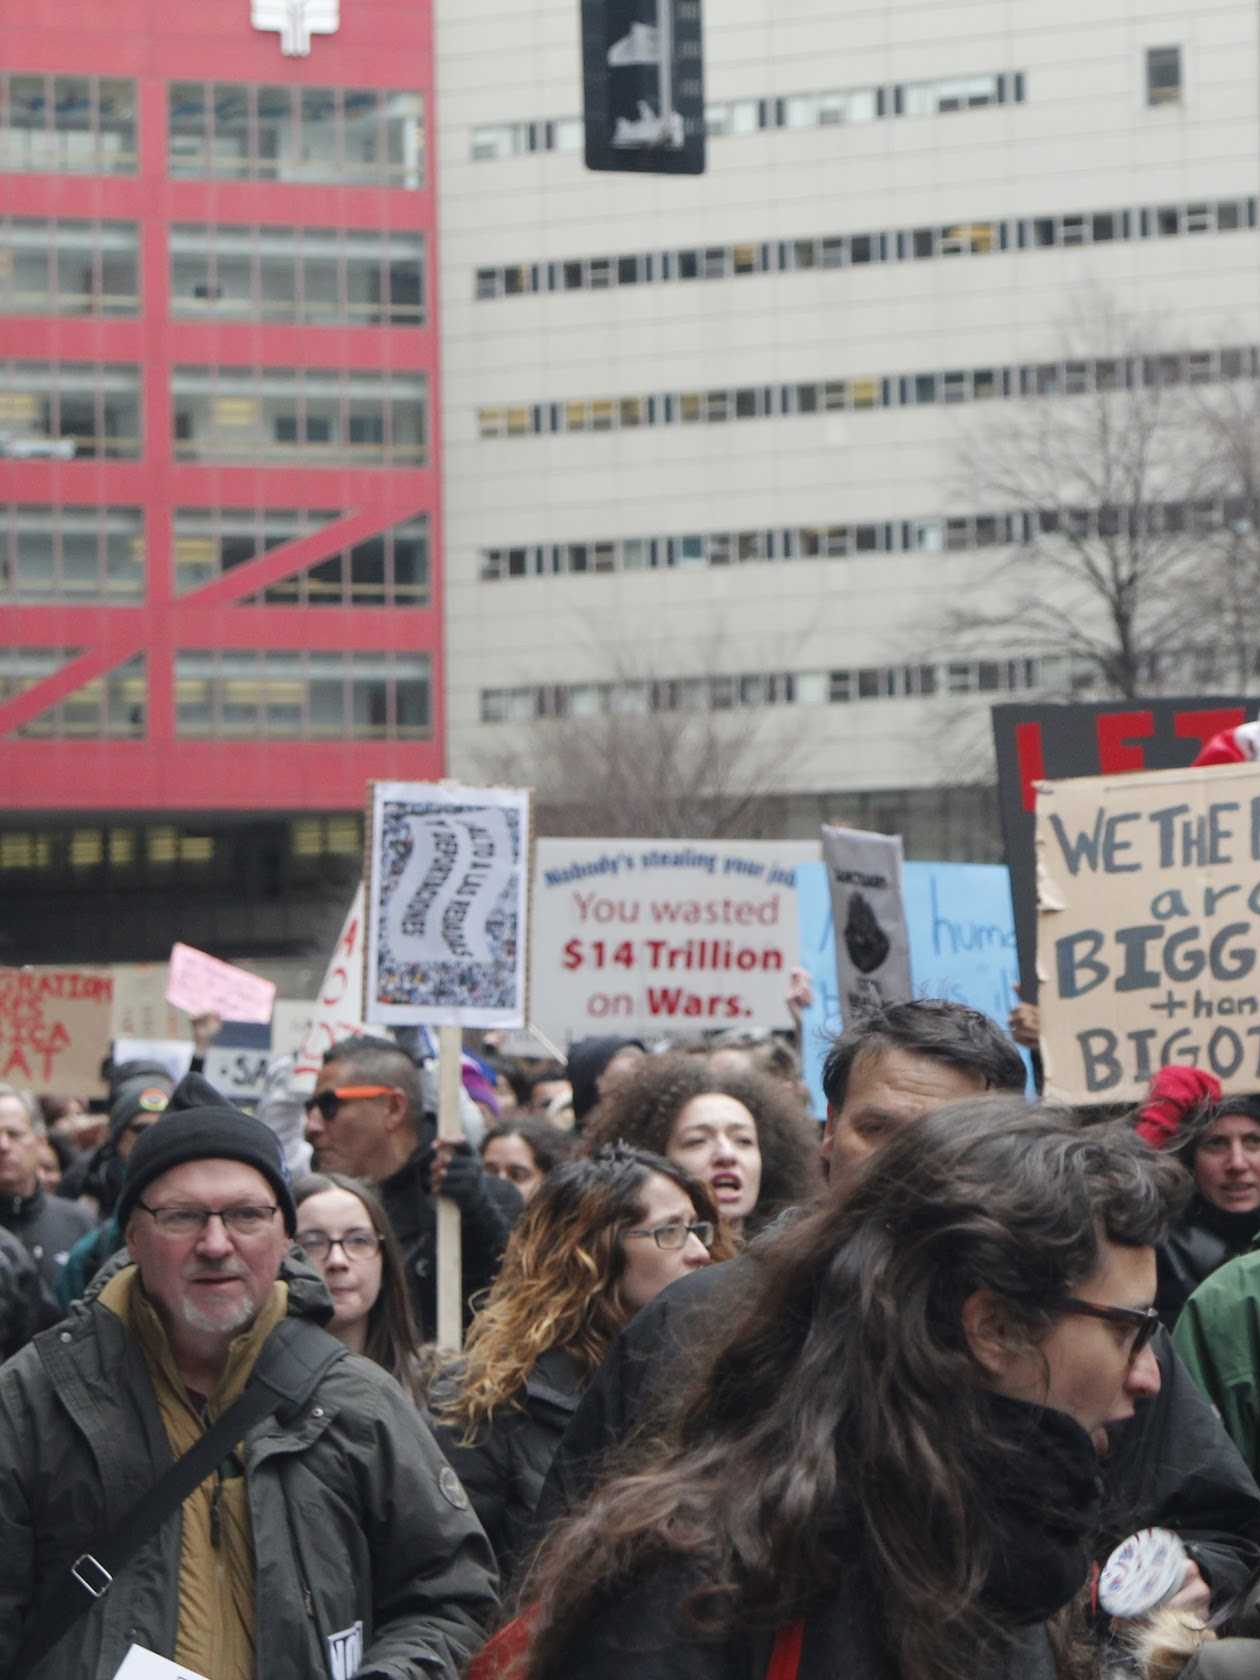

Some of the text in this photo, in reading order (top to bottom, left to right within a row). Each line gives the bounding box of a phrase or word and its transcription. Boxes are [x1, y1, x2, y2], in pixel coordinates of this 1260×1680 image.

[1048, 806, 1143, 876] WE
[1149, 802, 1240, 868] THE
[544, 852, 635, 888] Nobody's
[641, 847, 716, 874] stealing
[722, 858, 764, 878] your
[573, 891, 641, 926] You
[650, 894, 781, 927] wasted
[563, 938, 784, 972] $14 Trillion
[586, 984, 754, 1019] on Wars.
[1149, 989, 1258, 1020] than
